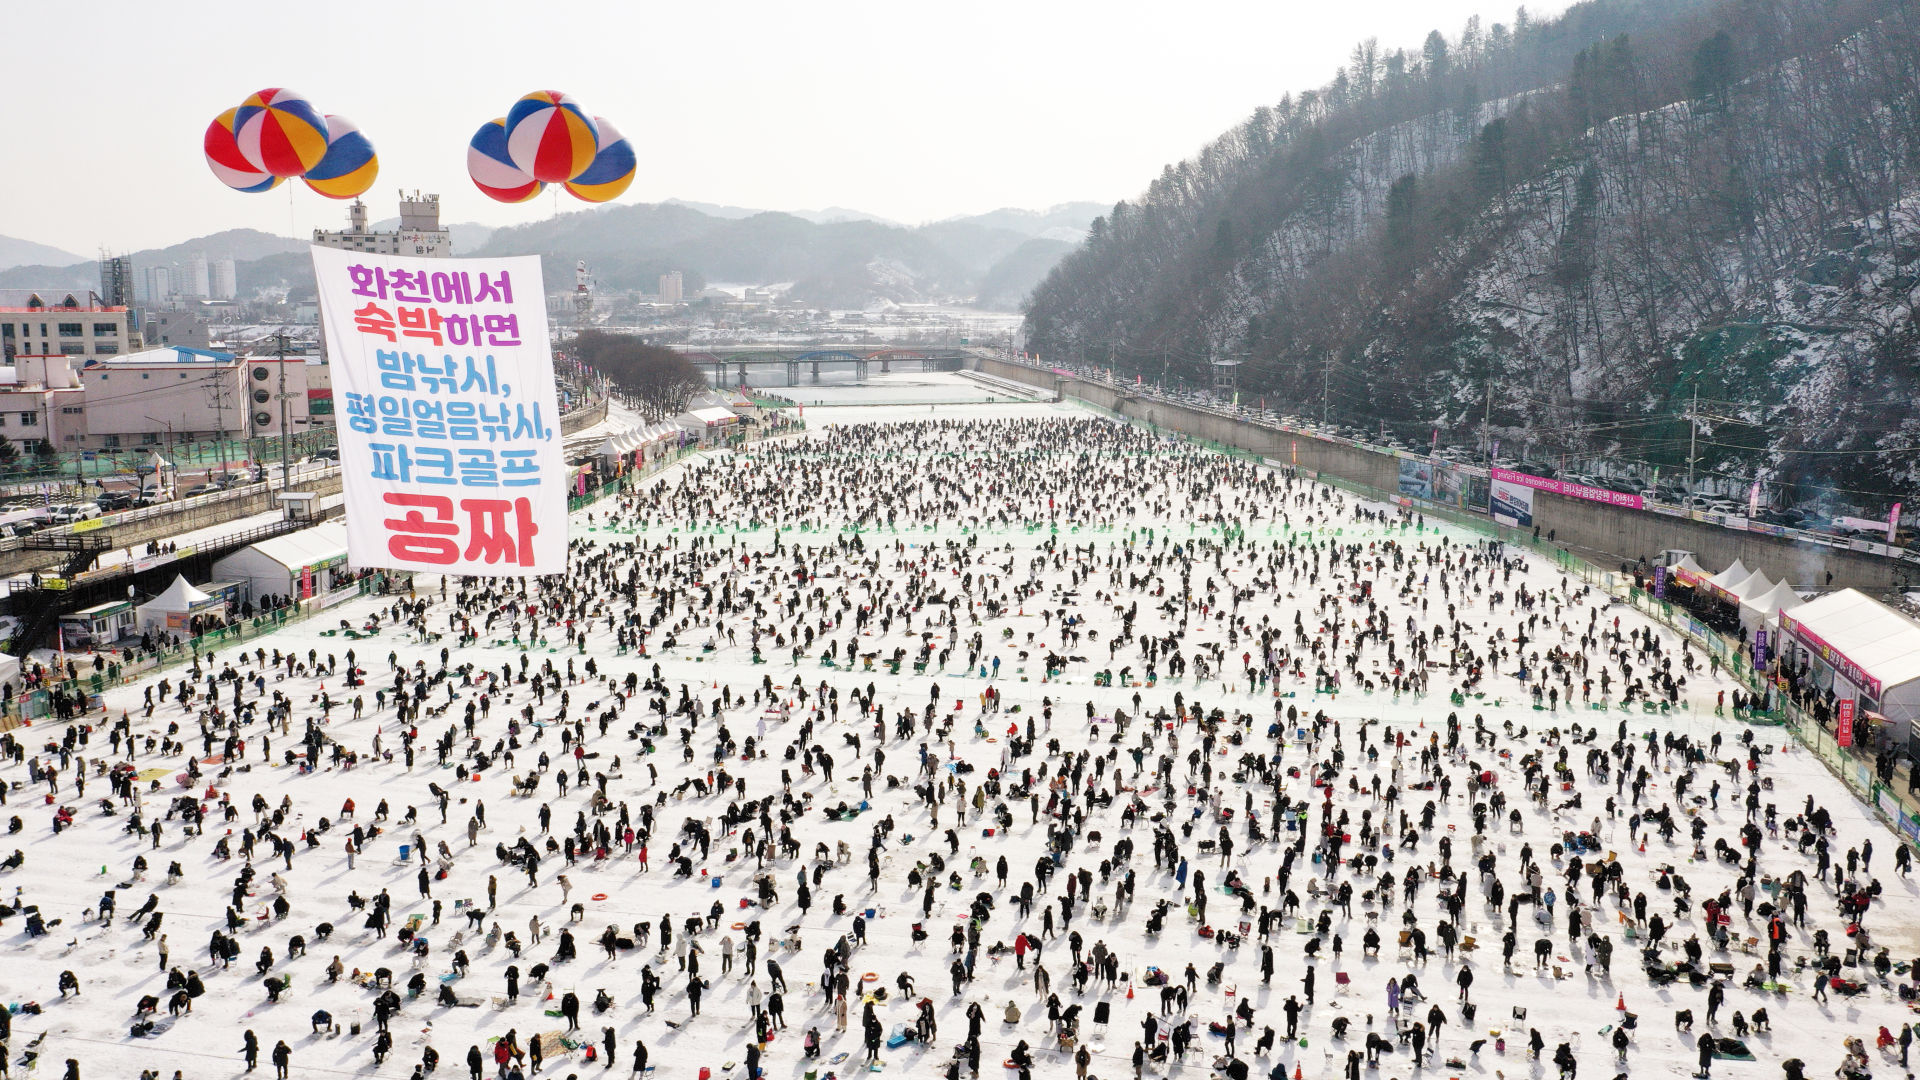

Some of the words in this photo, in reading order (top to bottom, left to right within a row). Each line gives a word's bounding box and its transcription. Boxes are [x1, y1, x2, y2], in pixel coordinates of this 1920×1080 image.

[346, 263, 513, 304] 화천에서
[353, 301, 522, 347] 숙박하면
[376, 349, 511, 397] 밤낚시,
[367, 442, 541, 488] 파크골프
[382, 491, 539, 568] 공짜
